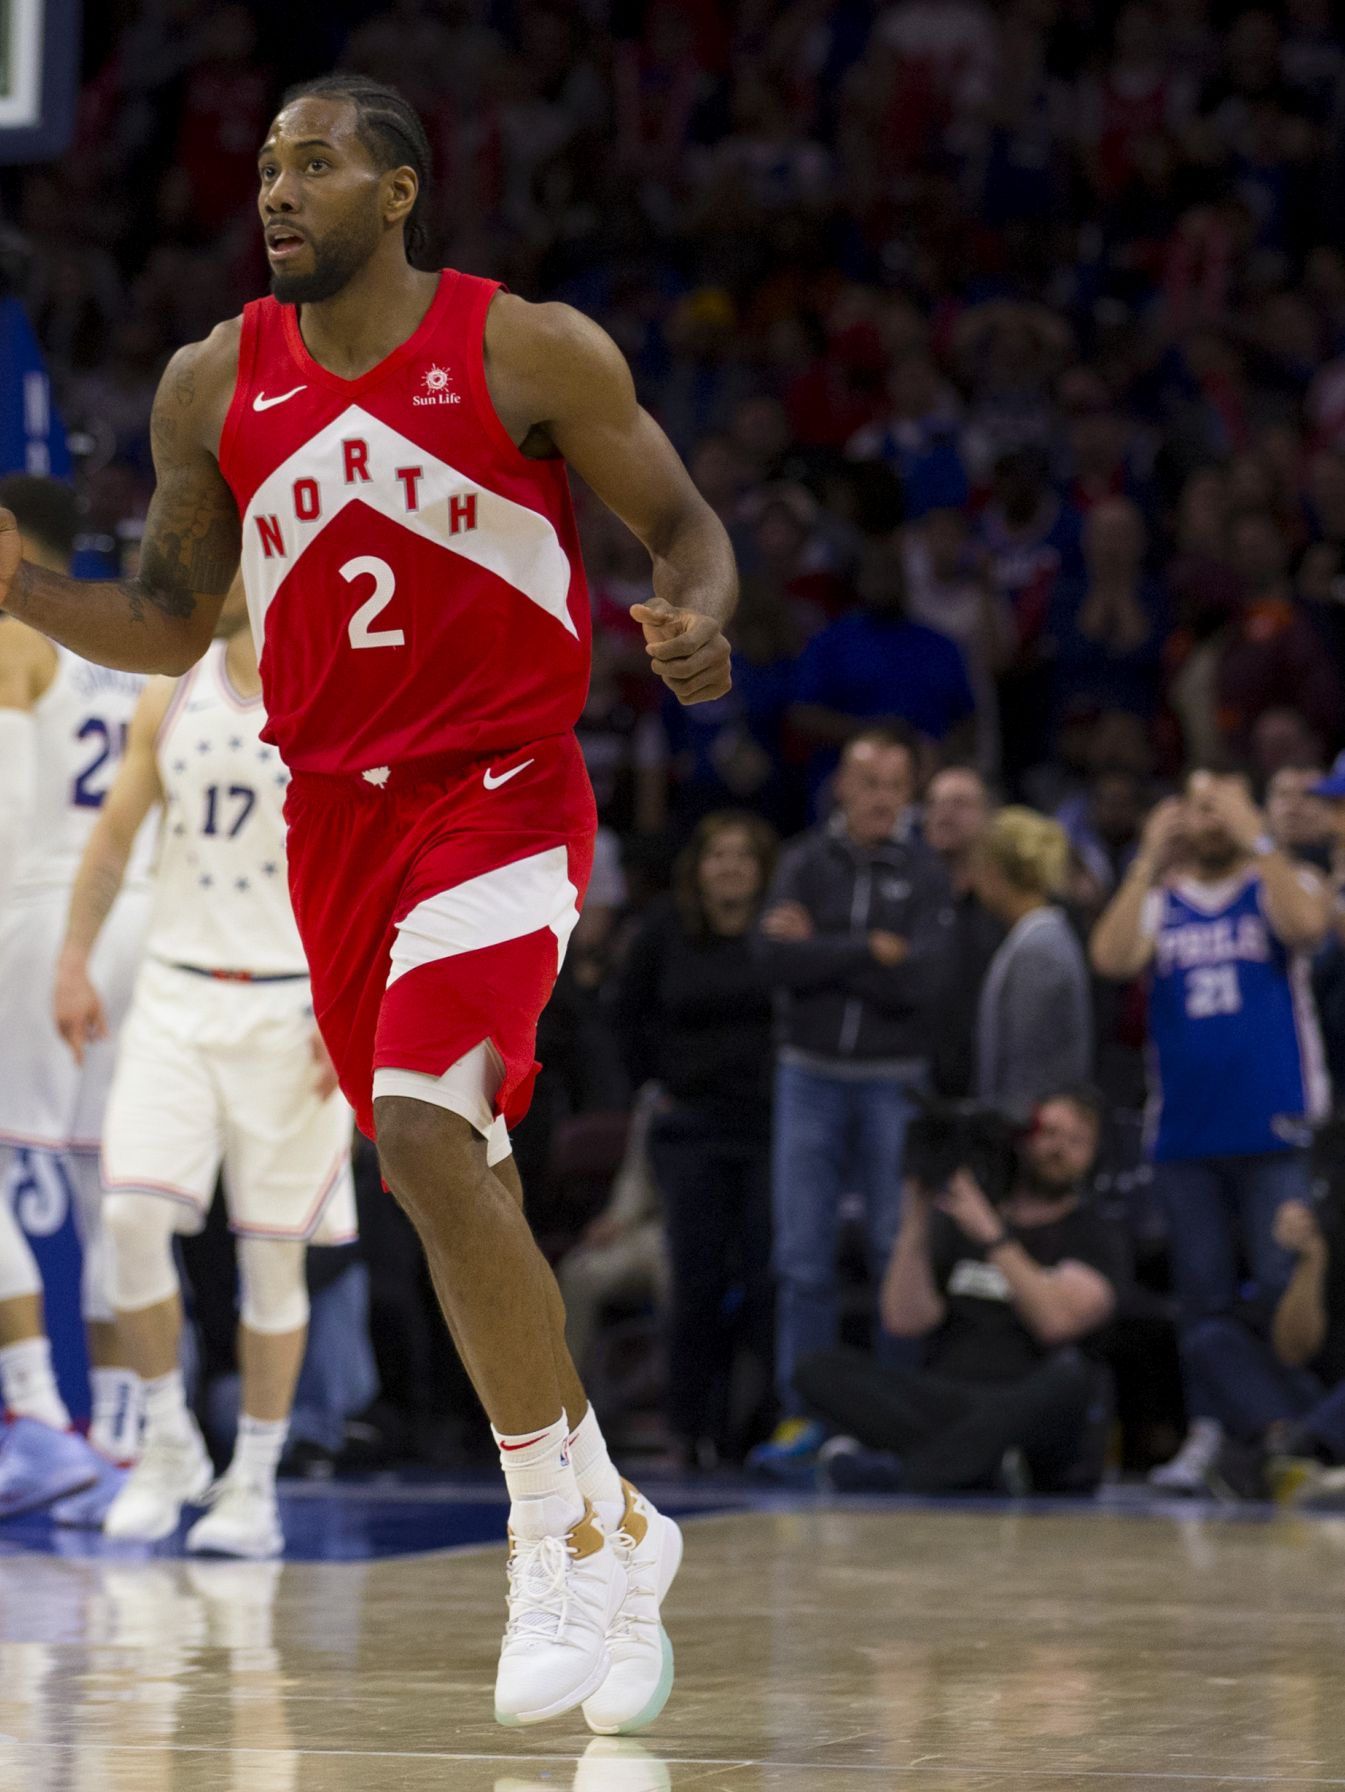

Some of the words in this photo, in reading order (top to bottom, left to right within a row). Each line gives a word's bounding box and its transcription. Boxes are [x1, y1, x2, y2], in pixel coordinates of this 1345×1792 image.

[412, 395, 436, 406] Sun
[439, 393, 462, 404] Life
[253, 437, 479, 560] NORTH
[338, 555, 406, 650] 2
[203, 784, 257, 840] 17
